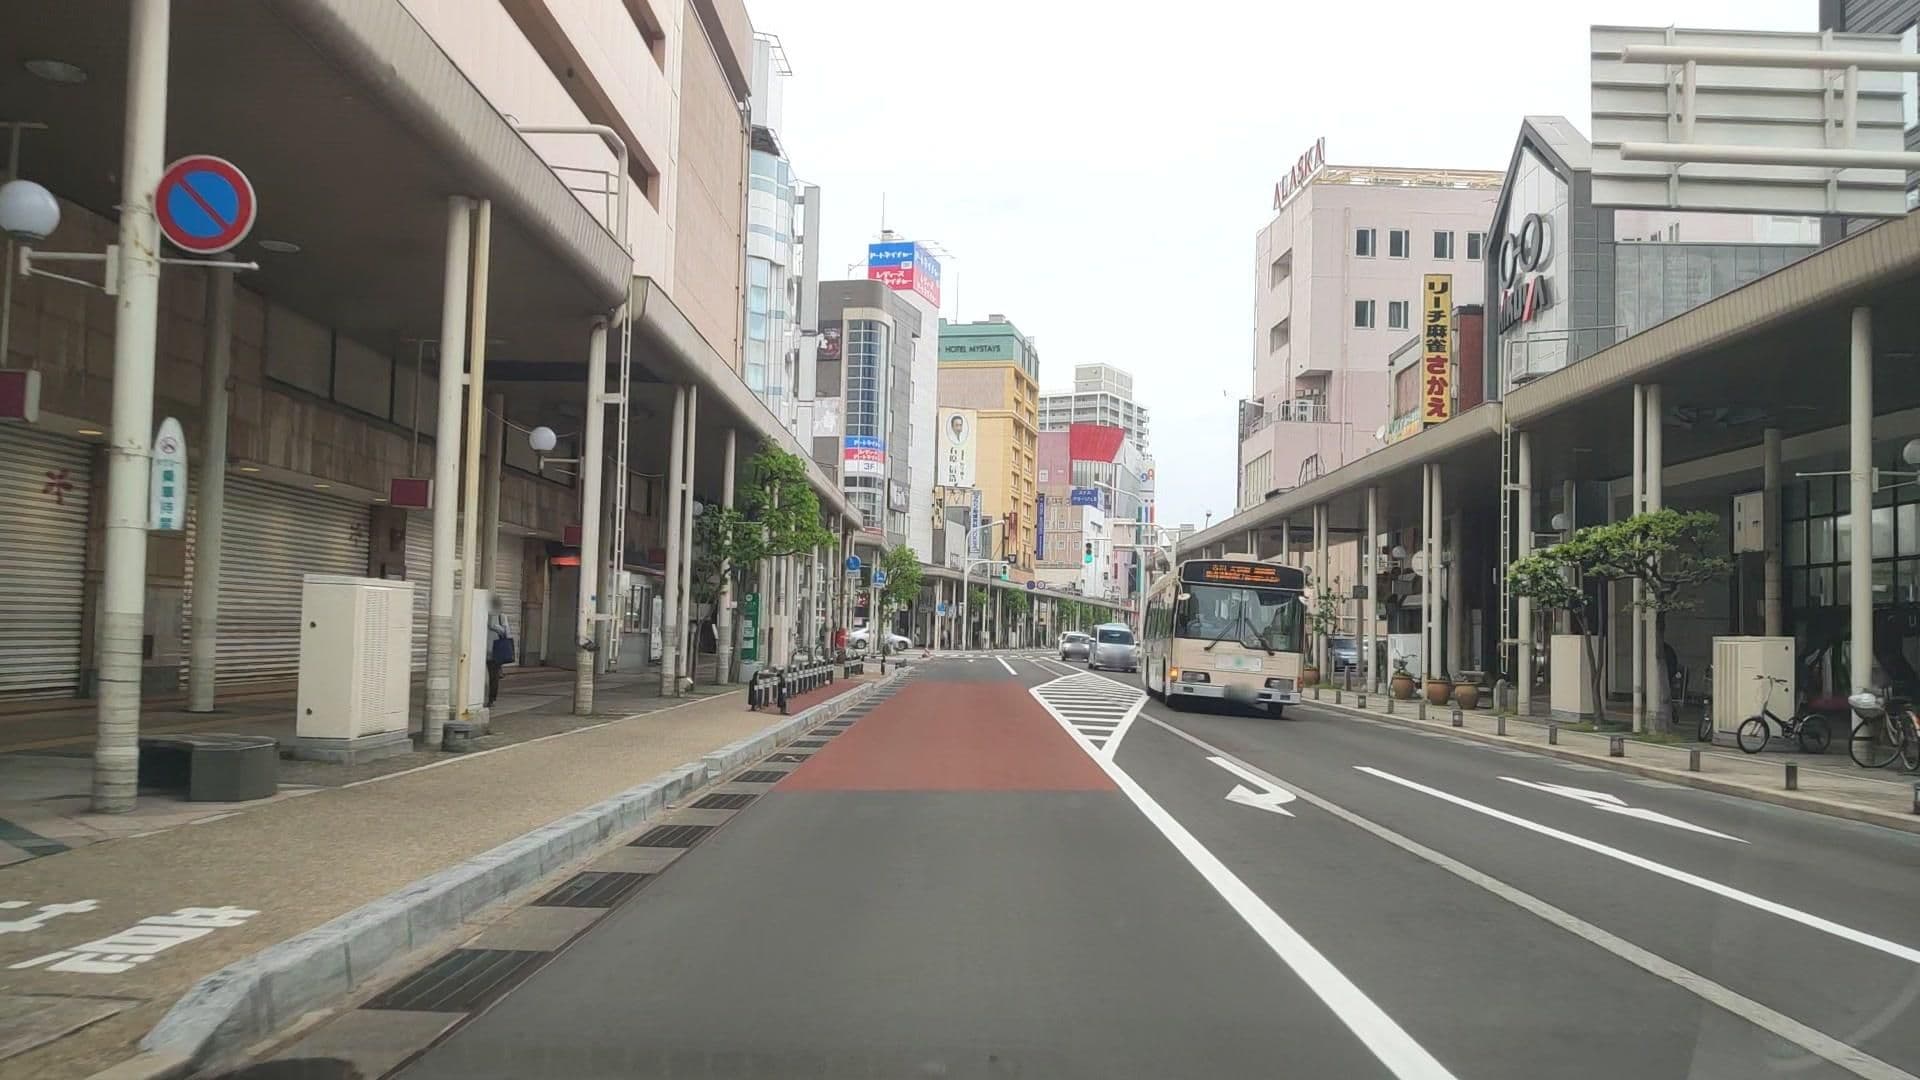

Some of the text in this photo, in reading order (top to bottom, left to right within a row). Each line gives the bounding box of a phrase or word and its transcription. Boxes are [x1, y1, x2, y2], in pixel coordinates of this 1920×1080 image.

[1273, 138, 1323, 210] ALASKA
[945, 345, 966, 353] HOTEL
[1427, 281, 1449, 418] リーチ麻雀さかえ
